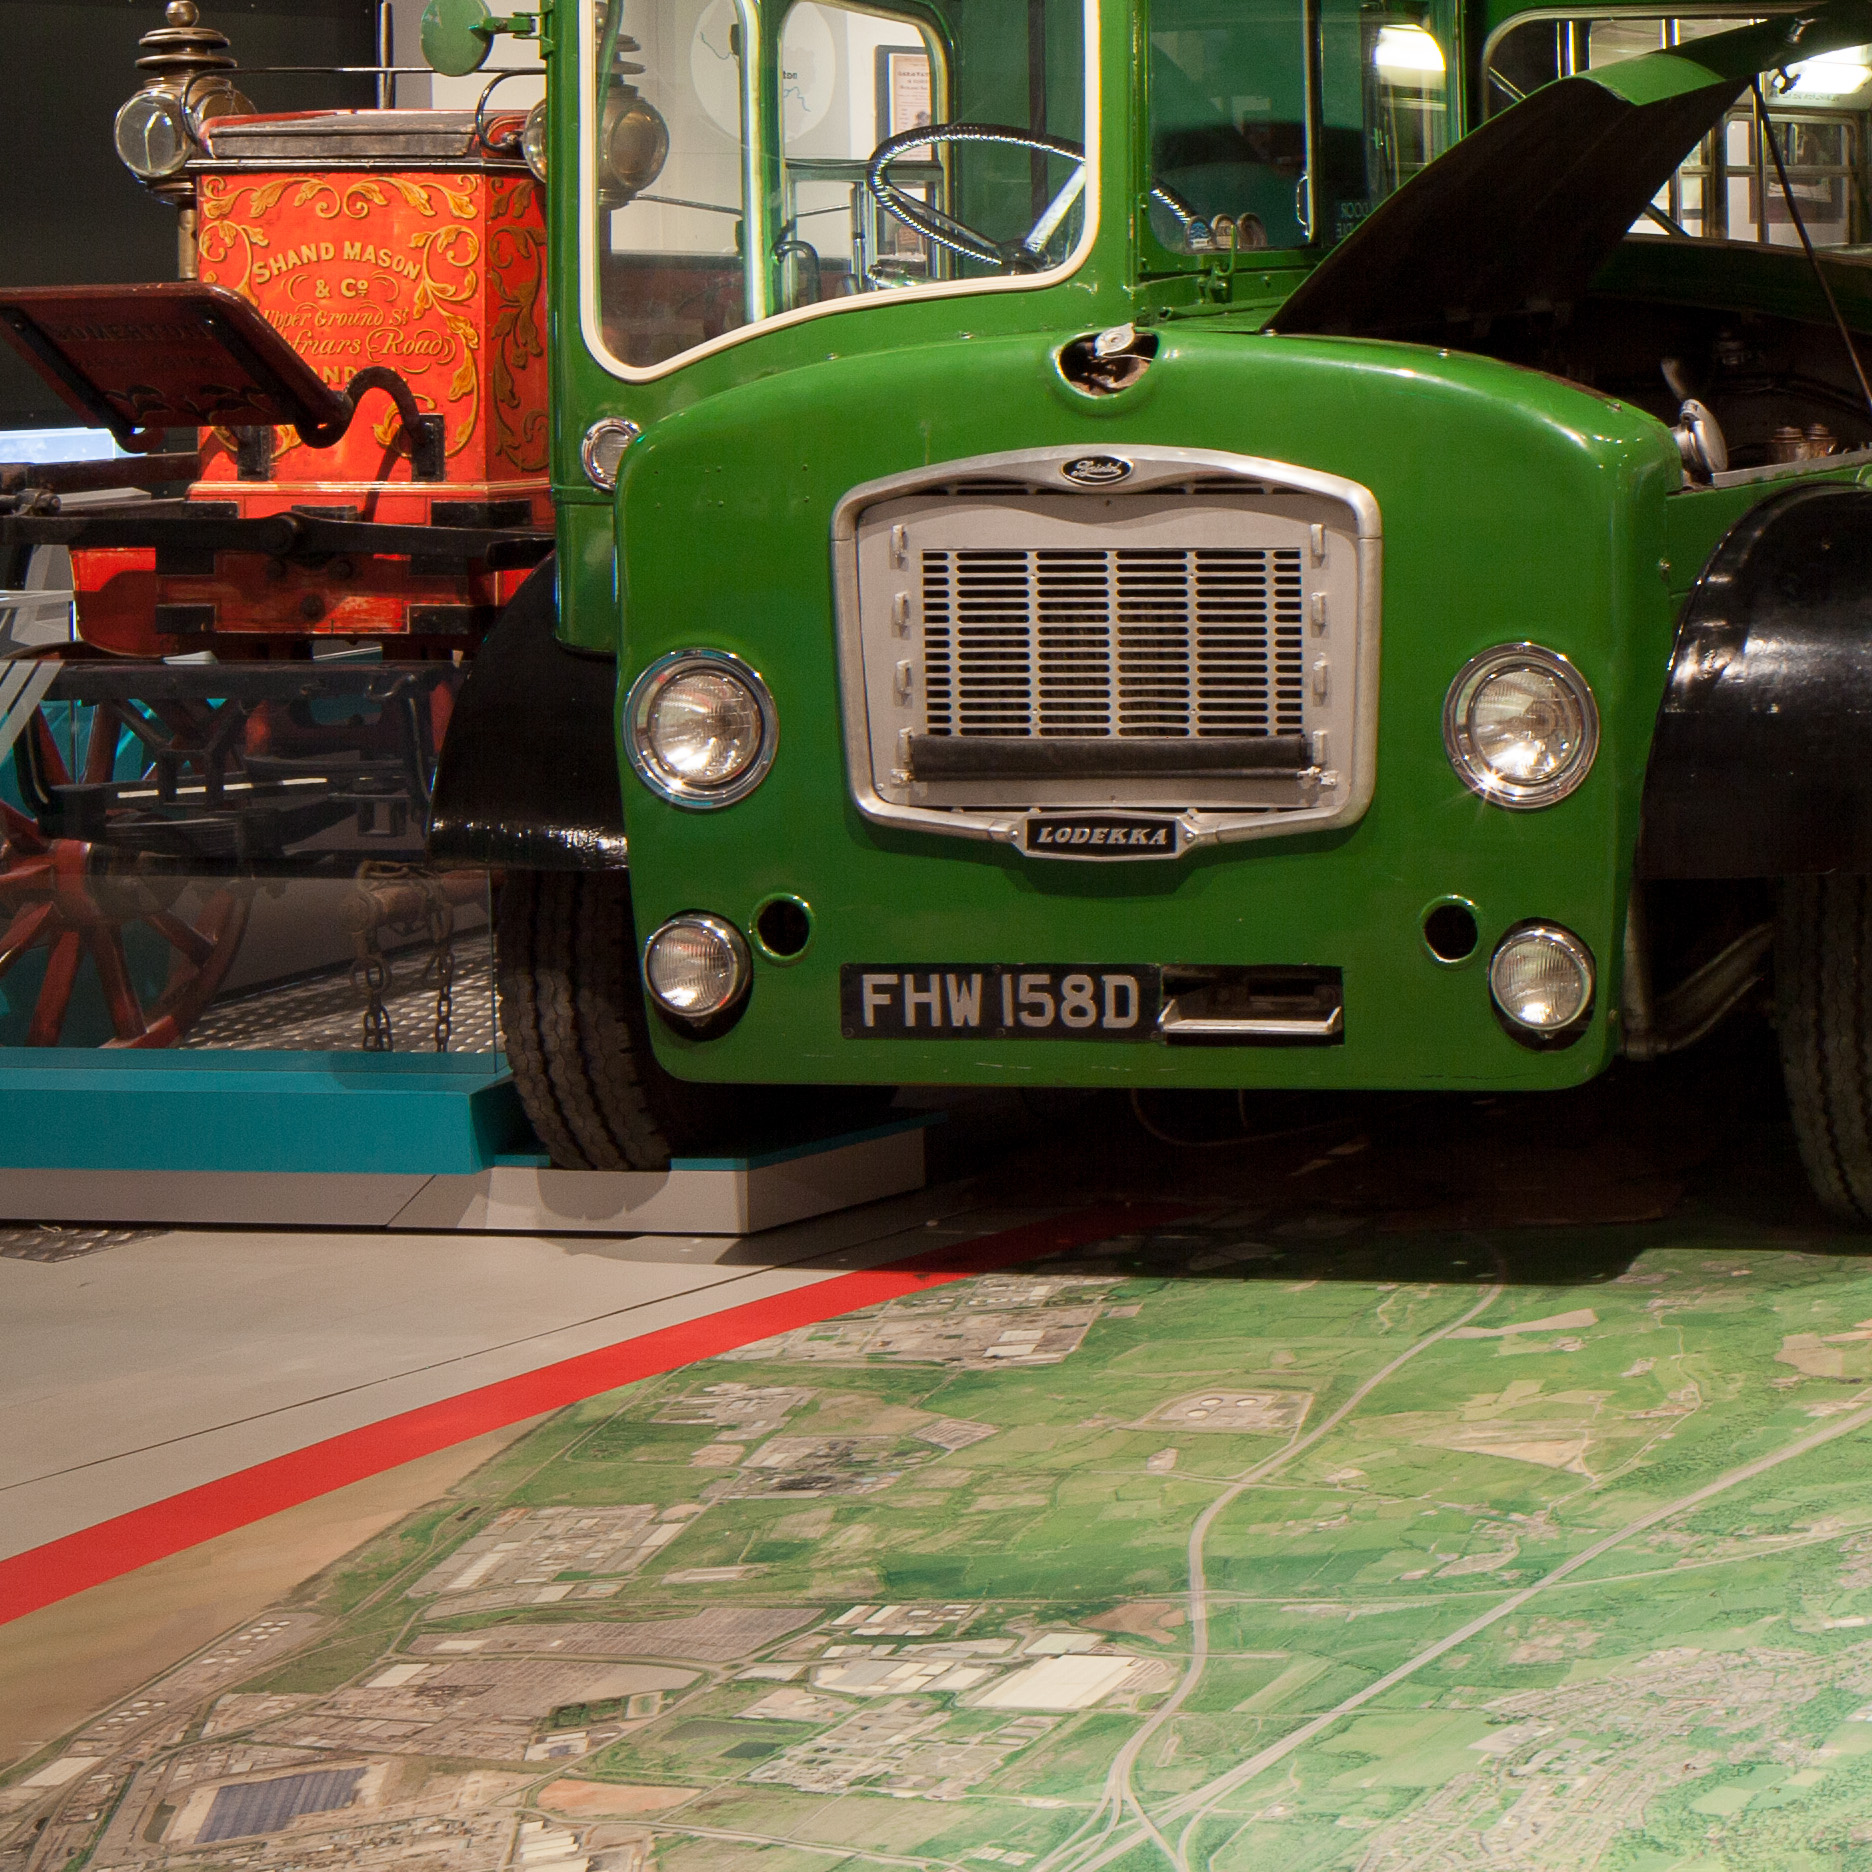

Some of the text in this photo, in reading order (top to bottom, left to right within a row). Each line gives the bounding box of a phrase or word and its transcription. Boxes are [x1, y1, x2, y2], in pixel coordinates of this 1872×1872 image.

[252, 241, 421, 284] SHAND MASON
[315, 279, 331, 298] &
[262, 306, 410, 328] Upper Ground St
[366, 327, 446, 363] Road
[1036, 826, 1169, 846] LODEKKA
[862, 973, 1139, 1028] FHW 158D
